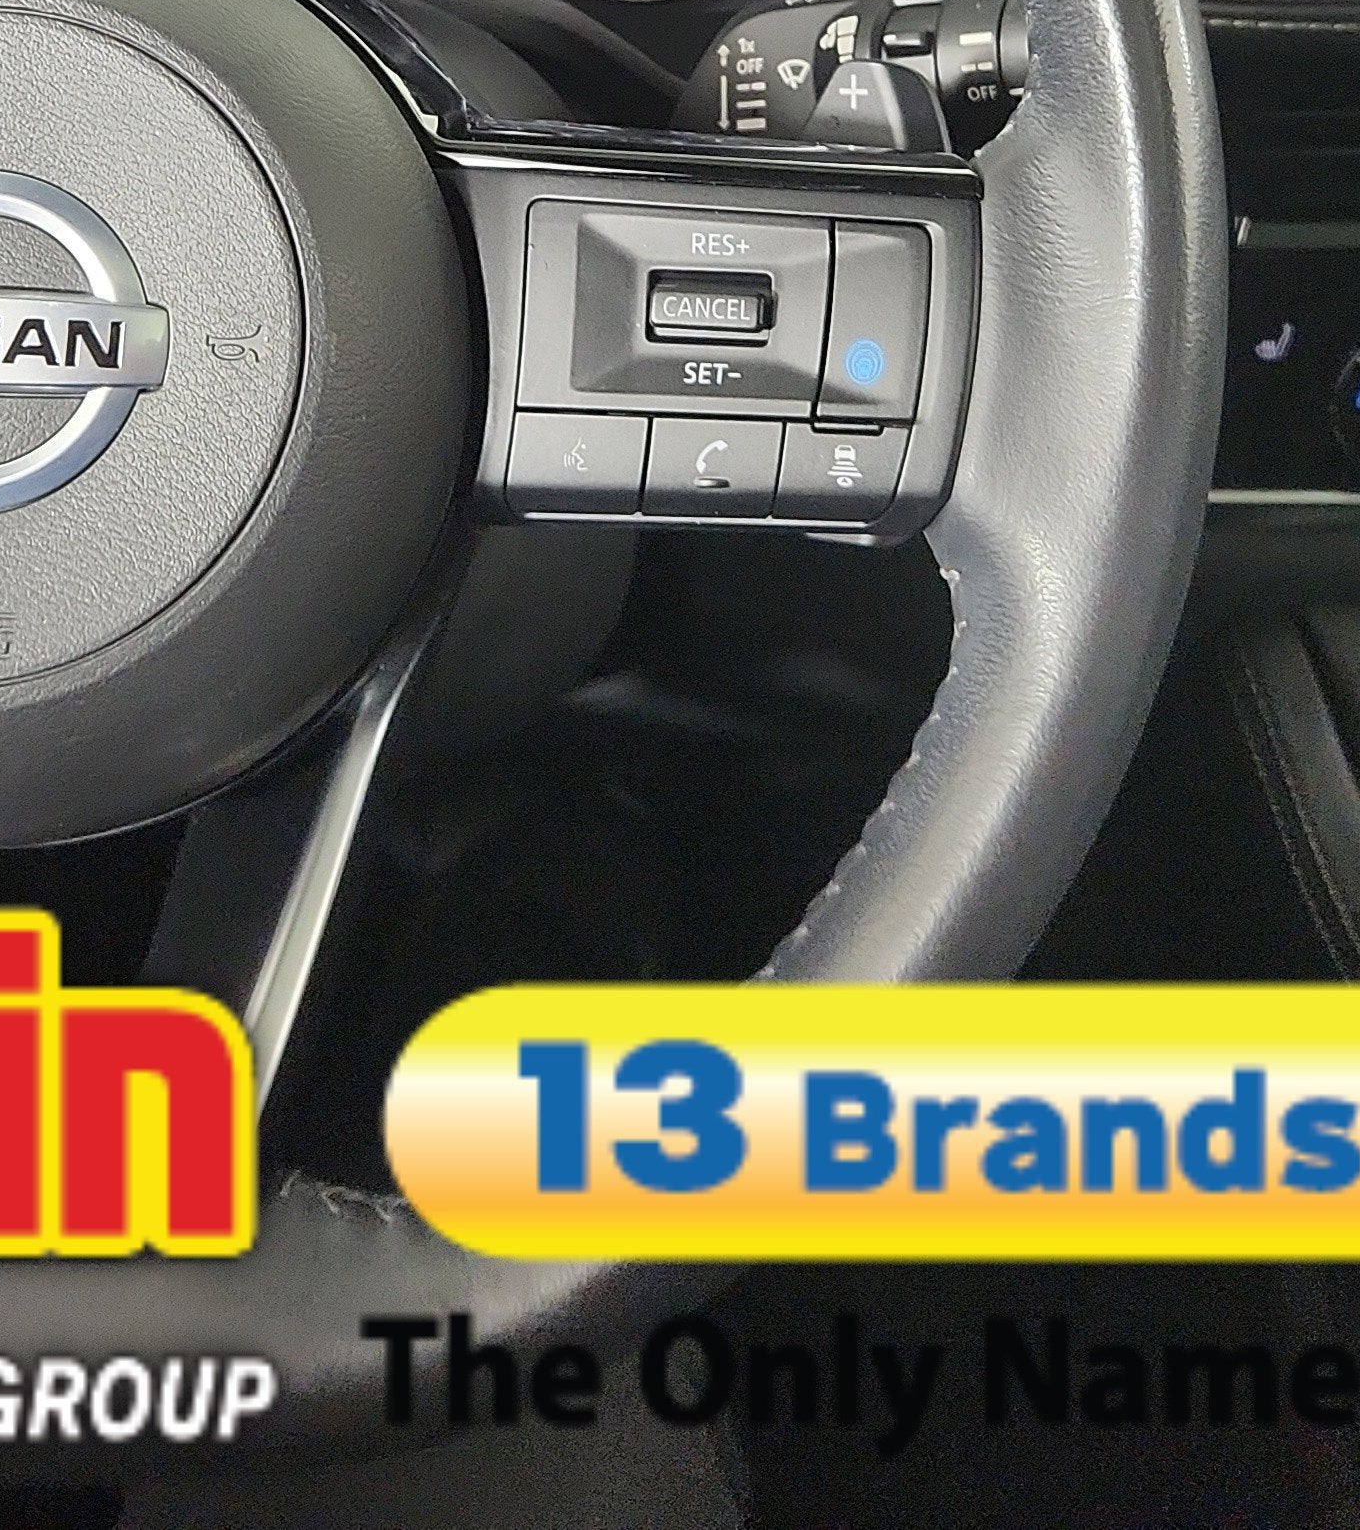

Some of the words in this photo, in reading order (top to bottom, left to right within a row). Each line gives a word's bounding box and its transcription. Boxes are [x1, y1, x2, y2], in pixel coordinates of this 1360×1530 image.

[736, 58, 764, 75] OFF
[967, 84, 998, 102] OFF
[691, 232, 751, 256] RES+
[662, 295, 751, 321] CANCEL
